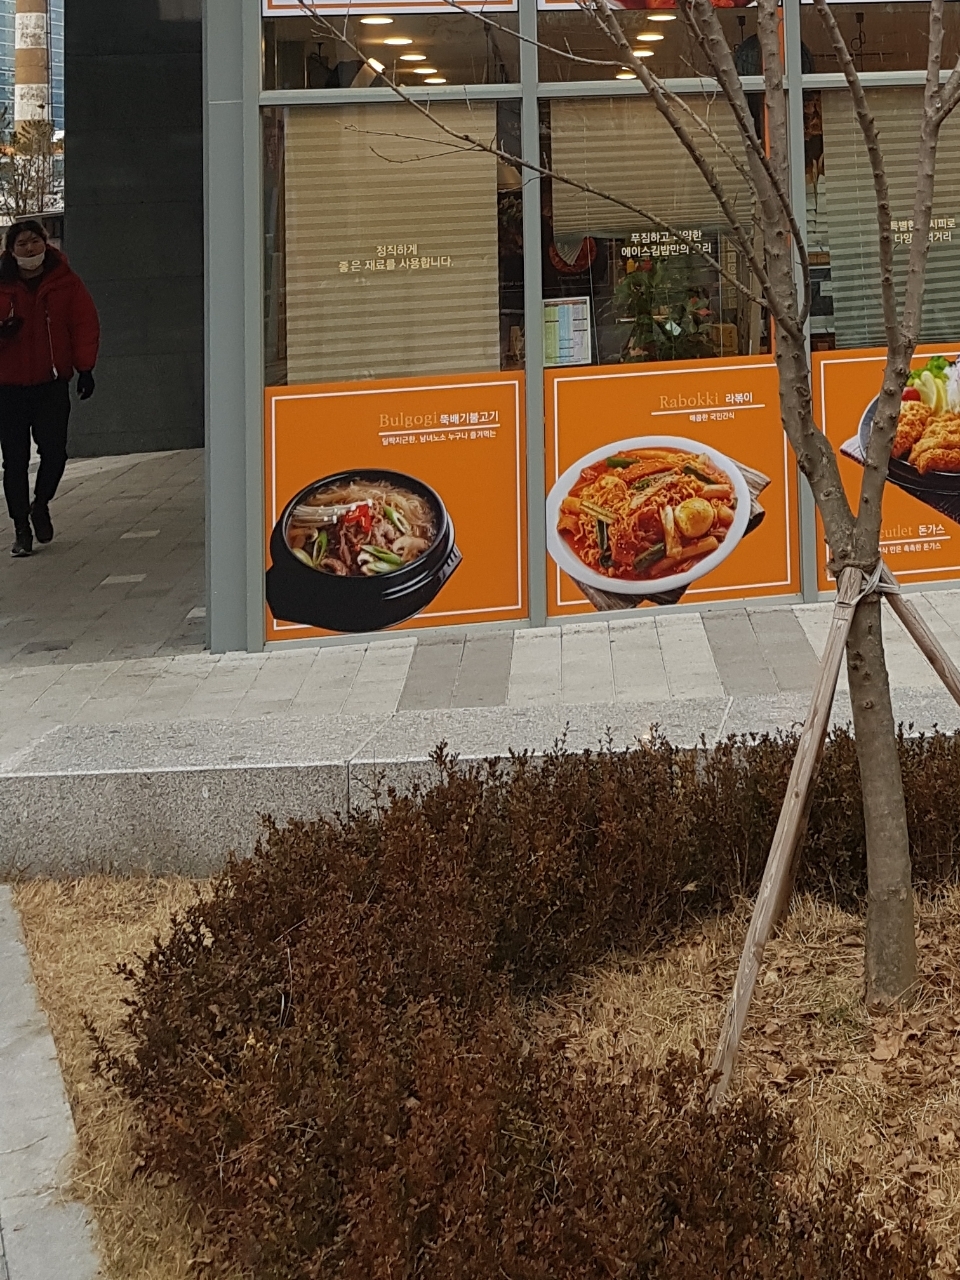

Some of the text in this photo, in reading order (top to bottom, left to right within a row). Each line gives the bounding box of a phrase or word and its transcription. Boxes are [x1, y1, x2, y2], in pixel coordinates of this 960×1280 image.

[927, 218, 956, 230] 시피로
[630, 231, 670, 244] 푸짐하고
[376, 243, 418, 257] 정직하게
[621, 244, 690, 258] 에이스김밥만의
[338, 256, 454, 273] 좋은 재료를 사용합니다.
[659, 391, 753, 409] Rabokki 라볶이
[379, 410, 499, 428] Bulgogi 뚝배기불고기
[918, 523, 946, 536] 돈가스
